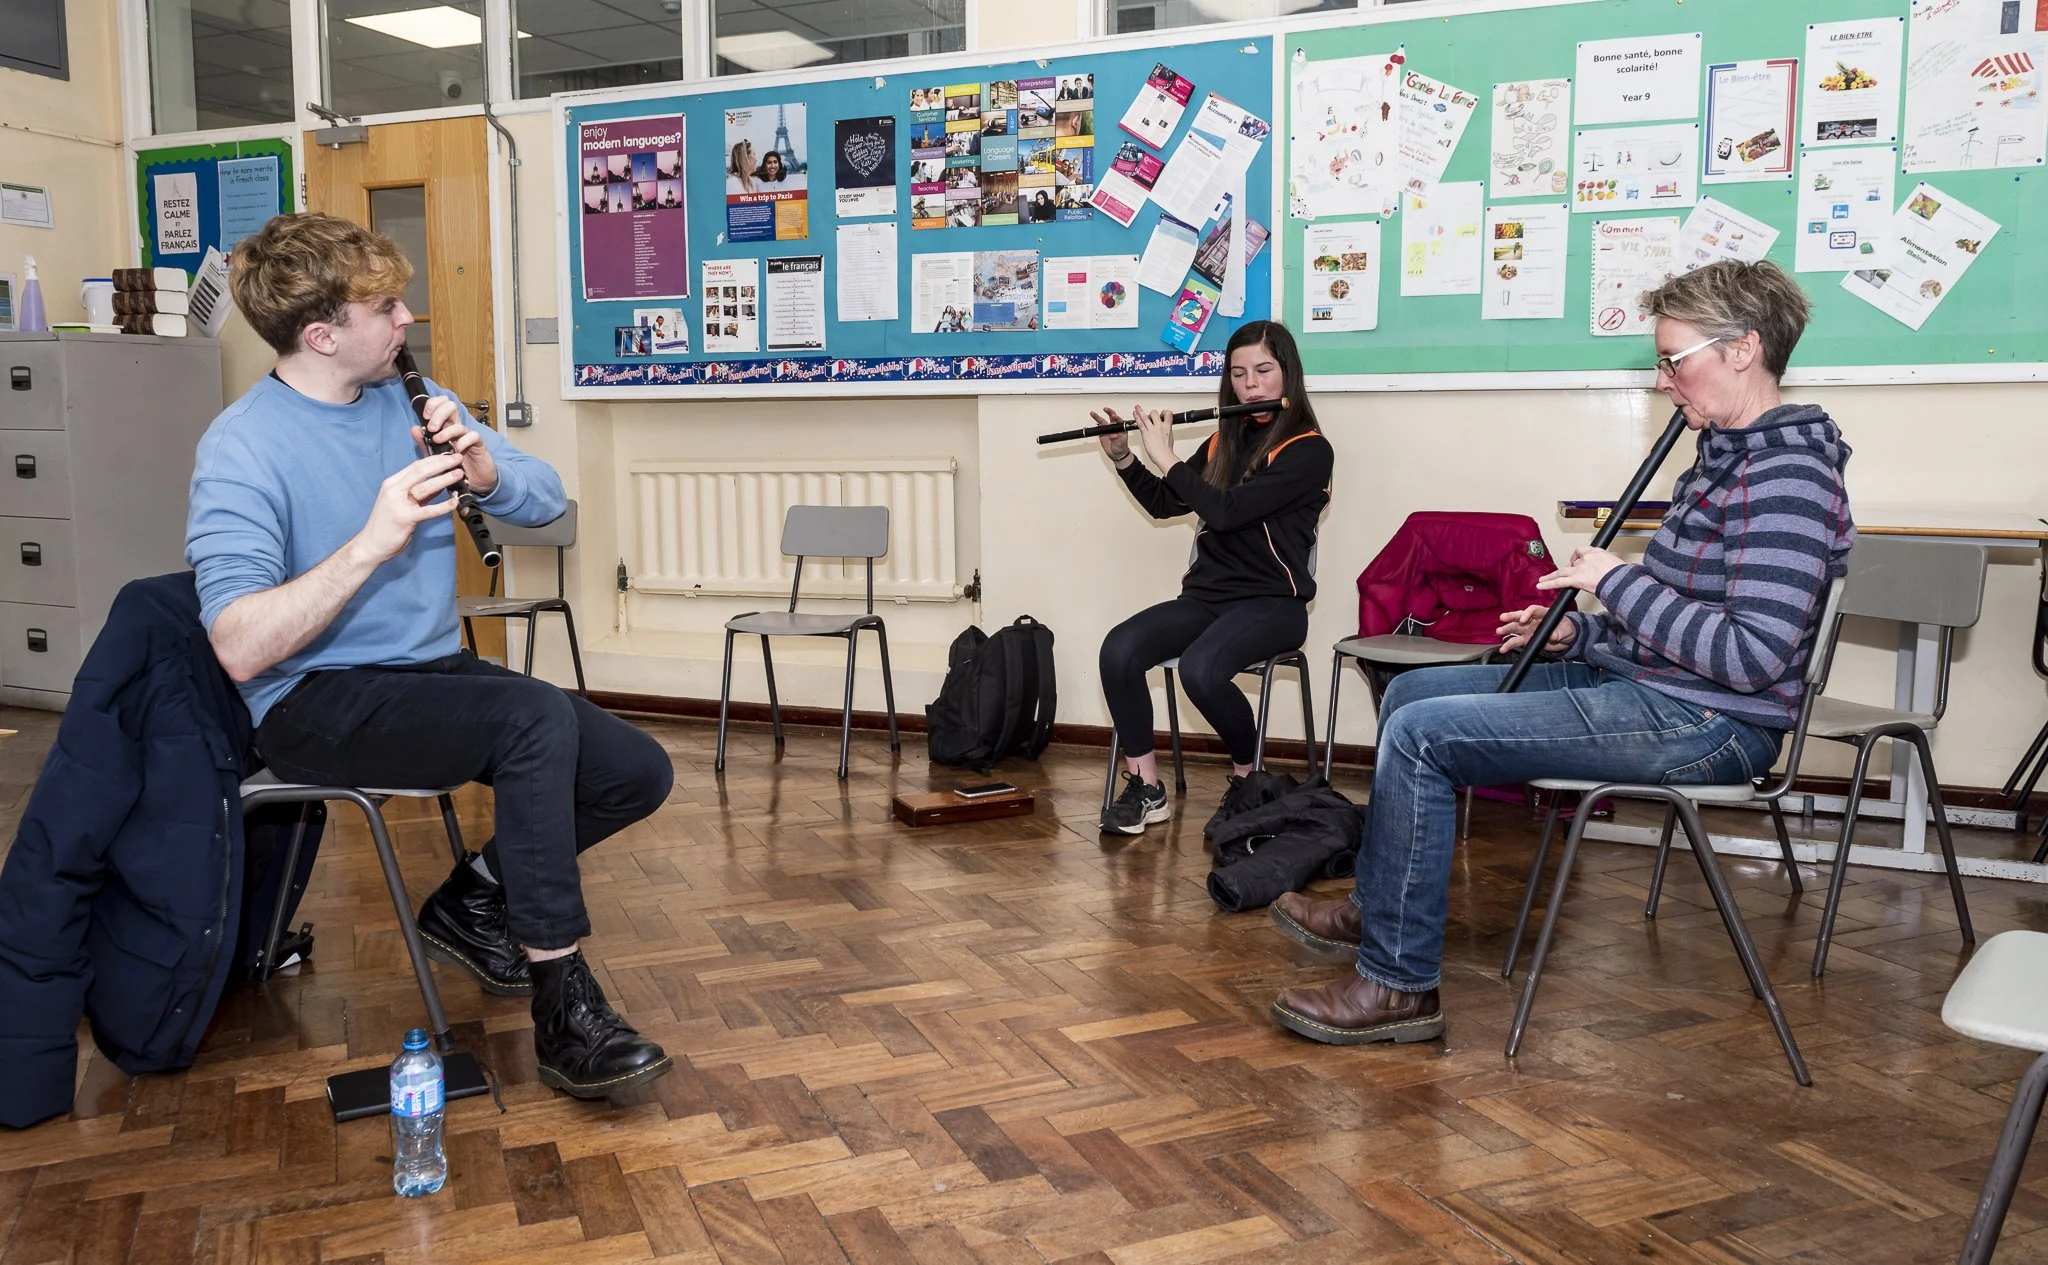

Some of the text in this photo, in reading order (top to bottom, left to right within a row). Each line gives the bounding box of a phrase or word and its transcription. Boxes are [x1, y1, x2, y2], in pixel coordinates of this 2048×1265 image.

[1624, 50, 1651, 60] santé,
[1654, 49, 1683, 57] bonne
[1616, 63, 1658, 73] scolarité!
[1731, 72, 1771, 83] Bien-être
[1020, 79, 1053, 87] Interpretation
[1622, 94, 1642, 102] Year
[1207, 105, 1232, 123] Accounting
[583, 126, 607, 139] enjoy
[583, 132, 682, 150] modern languages?
[164, 199, 190, 208] RESTEZ
[164, 210, 190, 219] CALME
[1602, 223, 1643, 233] Comment
[164, 229, 192, 238] PARLEZ
[161, 240, 198, 250] FRANÇAIS
[1900, 237, 1947, 266] Alimentation
[791, 261, 819, 272] français
